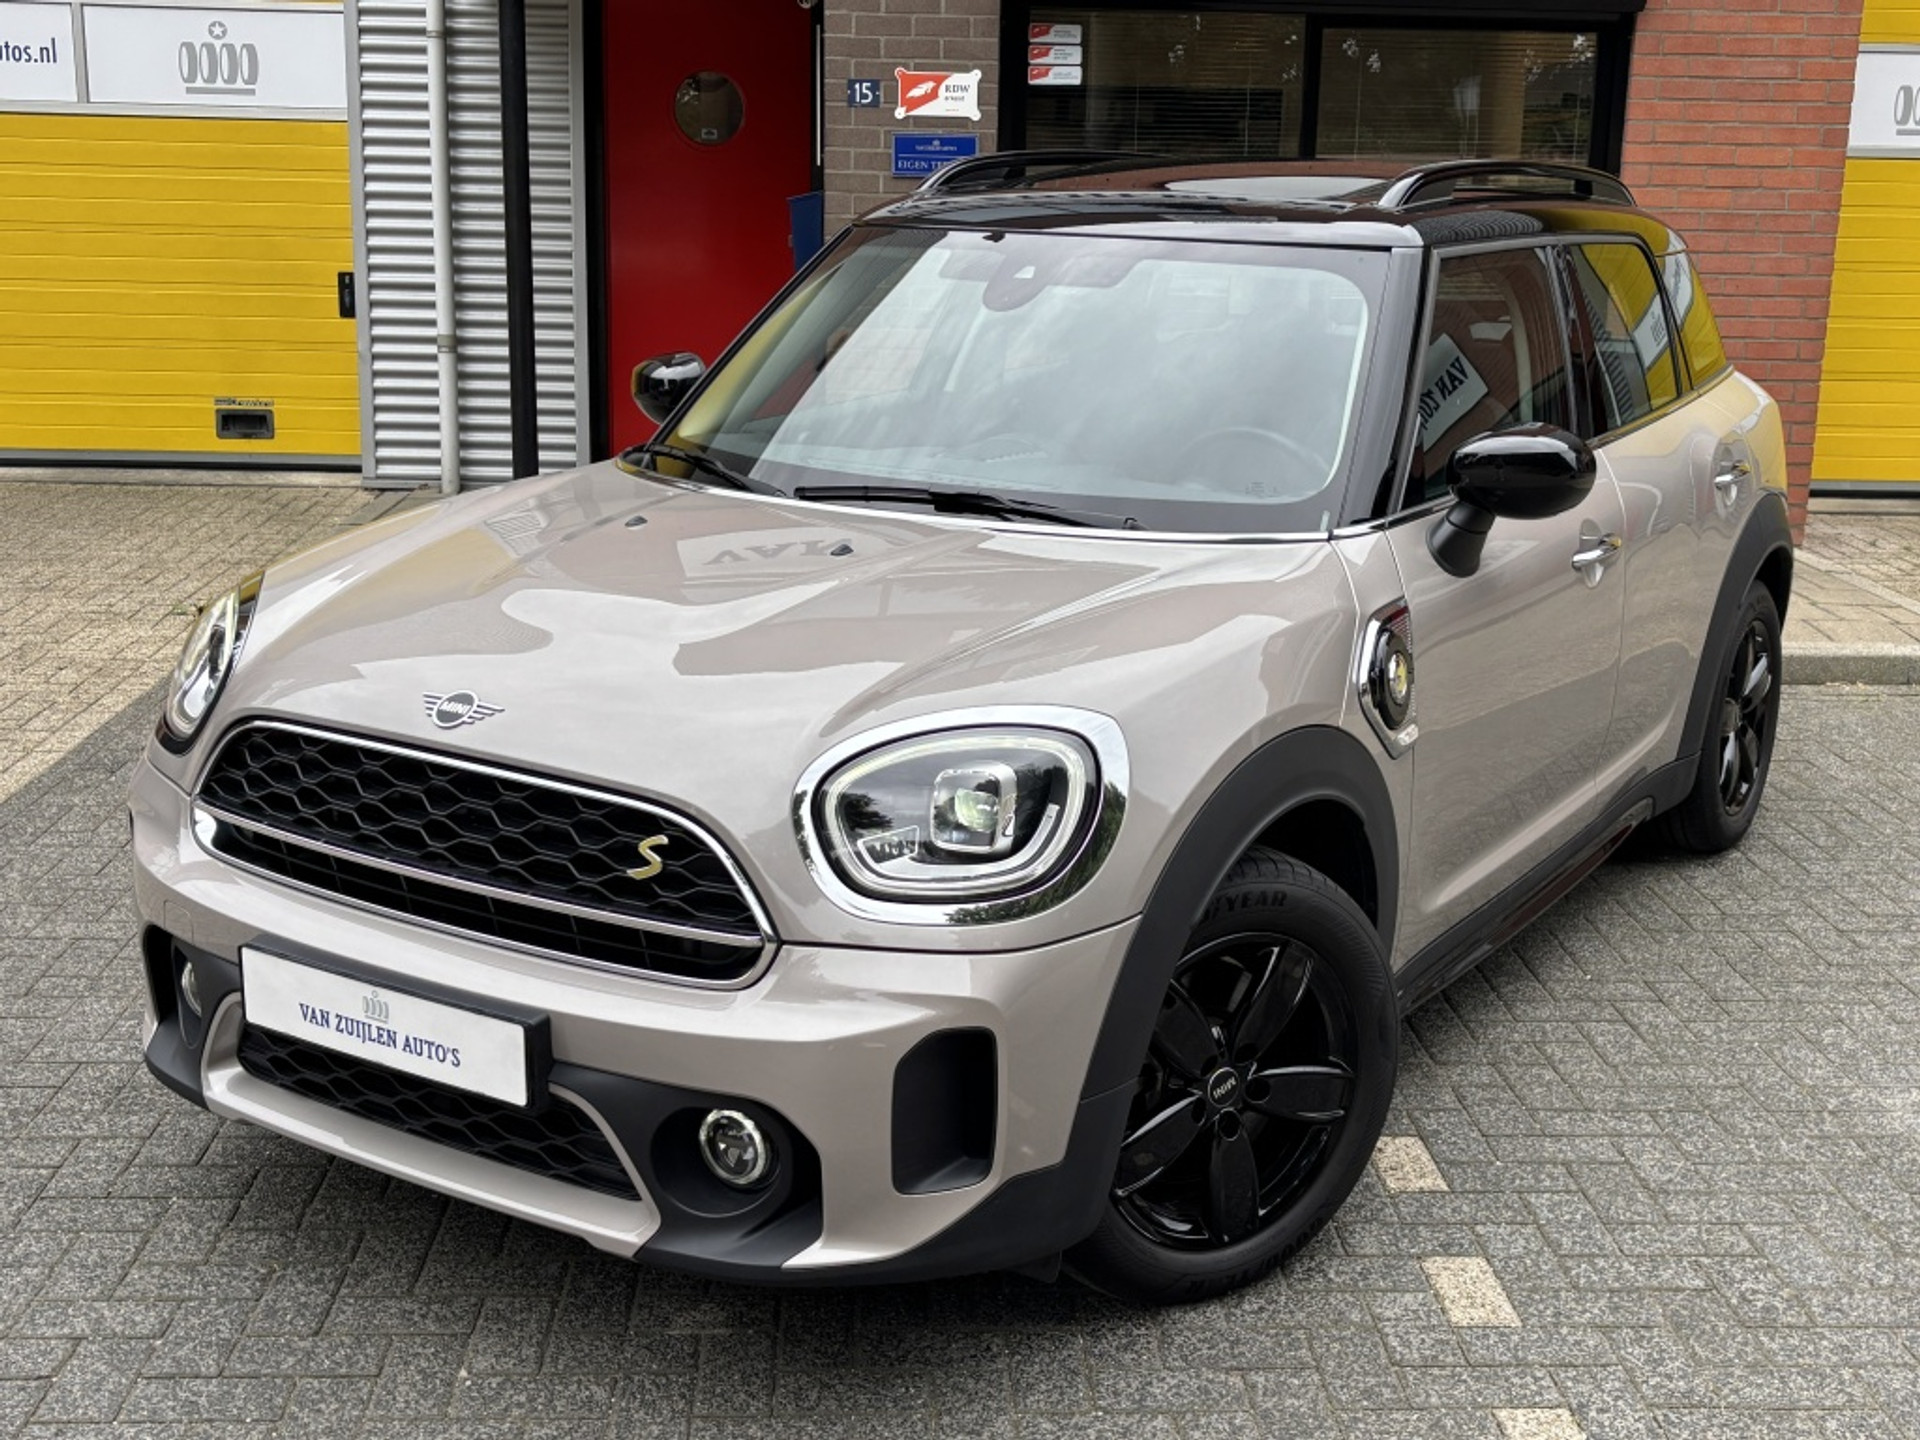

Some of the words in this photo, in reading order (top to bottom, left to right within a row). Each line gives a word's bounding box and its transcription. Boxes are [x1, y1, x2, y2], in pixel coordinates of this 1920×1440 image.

[0, 37, 57, 63] tos.nl
[854, 82, 873, 103] 15
[944, 84, 971, 93] RDW
[898, 160, 928, 170] EIGEN
[440, 700, 472, 715] MINI
[626, 834, 669, 880] S
[299, 1002, 331, 1029] VAN
[335, 1012, 397, 1049] ZUIJLEN
[402, 1034, 461, 1068] AUTO'S
